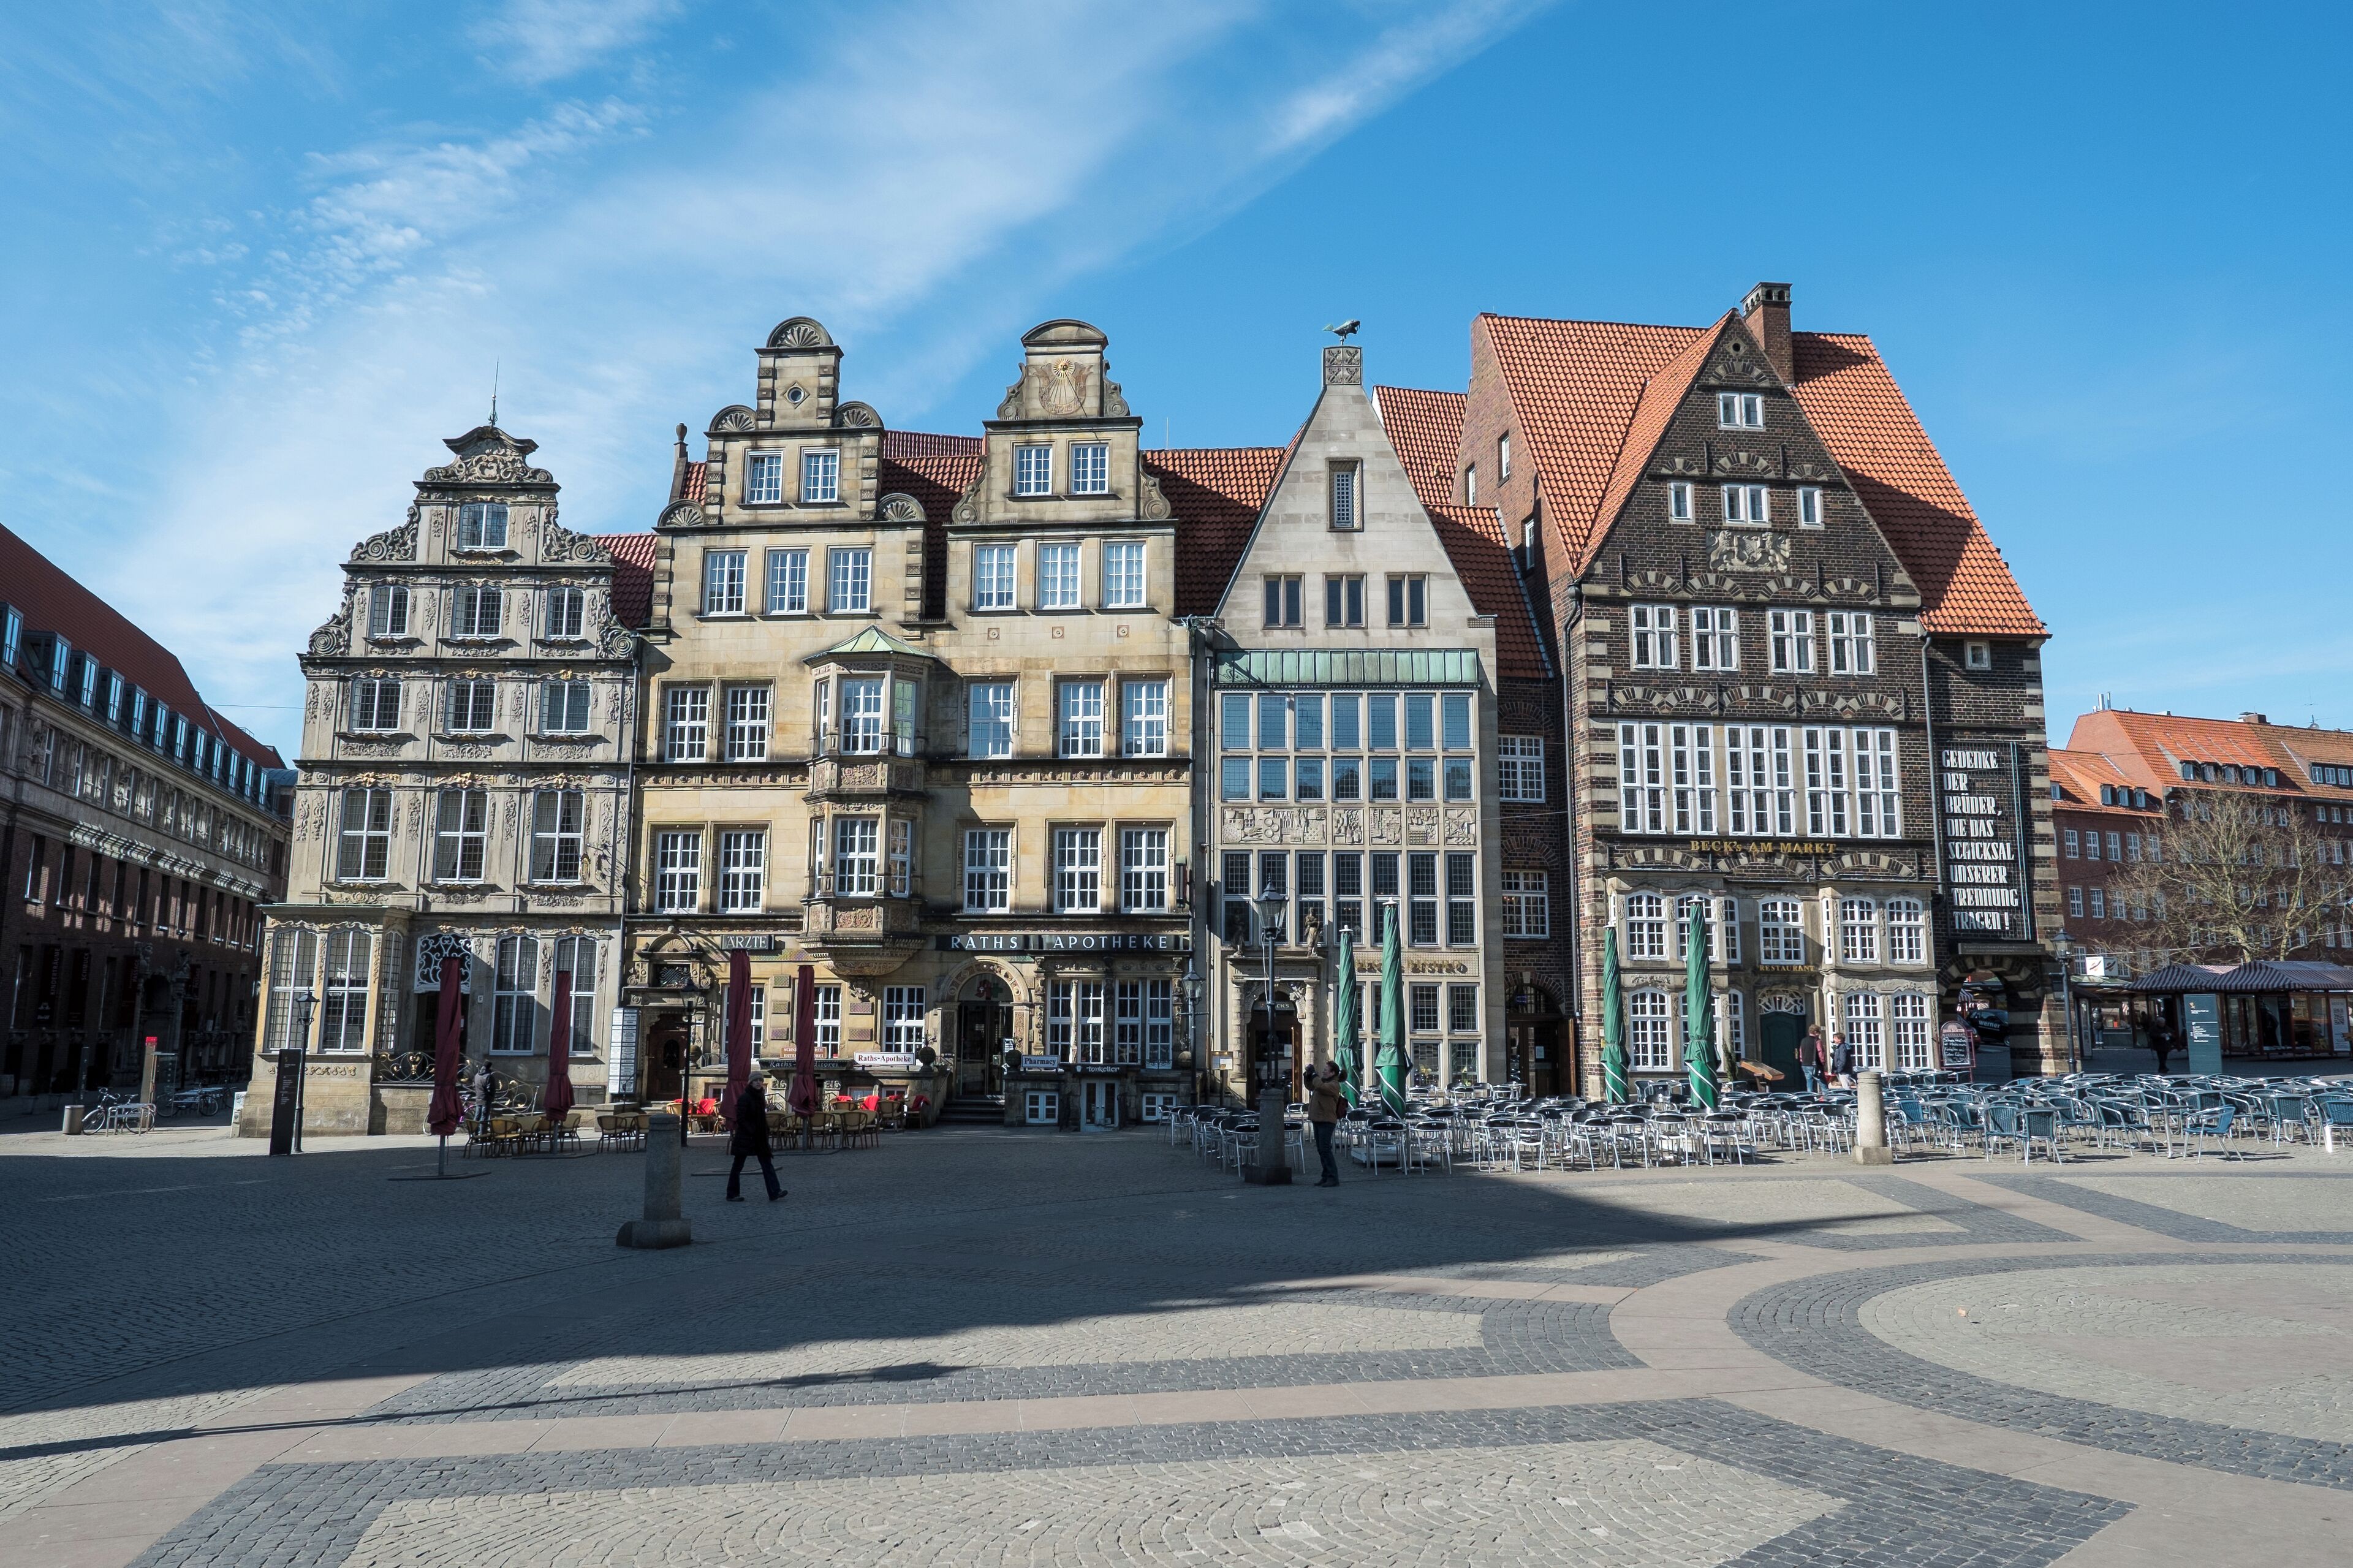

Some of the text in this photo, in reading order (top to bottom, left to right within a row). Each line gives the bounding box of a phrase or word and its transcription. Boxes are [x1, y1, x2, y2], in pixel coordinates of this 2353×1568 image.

[1942, 750, 1998, 768] GEDENKE
[1943, 772, 1969, 791] DER
[1945, 793, 2003, 816] BRÜDER,
[1946, 819, 1995, 837] DIE DAS
[1749, 842, 1772, 852] AM
[1779, 843, 1836, 853] MARKT
[1948, 841, 2014, 860] SCHICKSAL
[1949, 865, 2008, 884] UNSERER
[1951, 887, 2018, 907] TRENNUNG
[726, 936, 767, 949] ÄRZTE
[951, 936, 1168, 949] RATHS APOTHEKE
[858, 1055, 911, 1063] Raths-Apotheke
